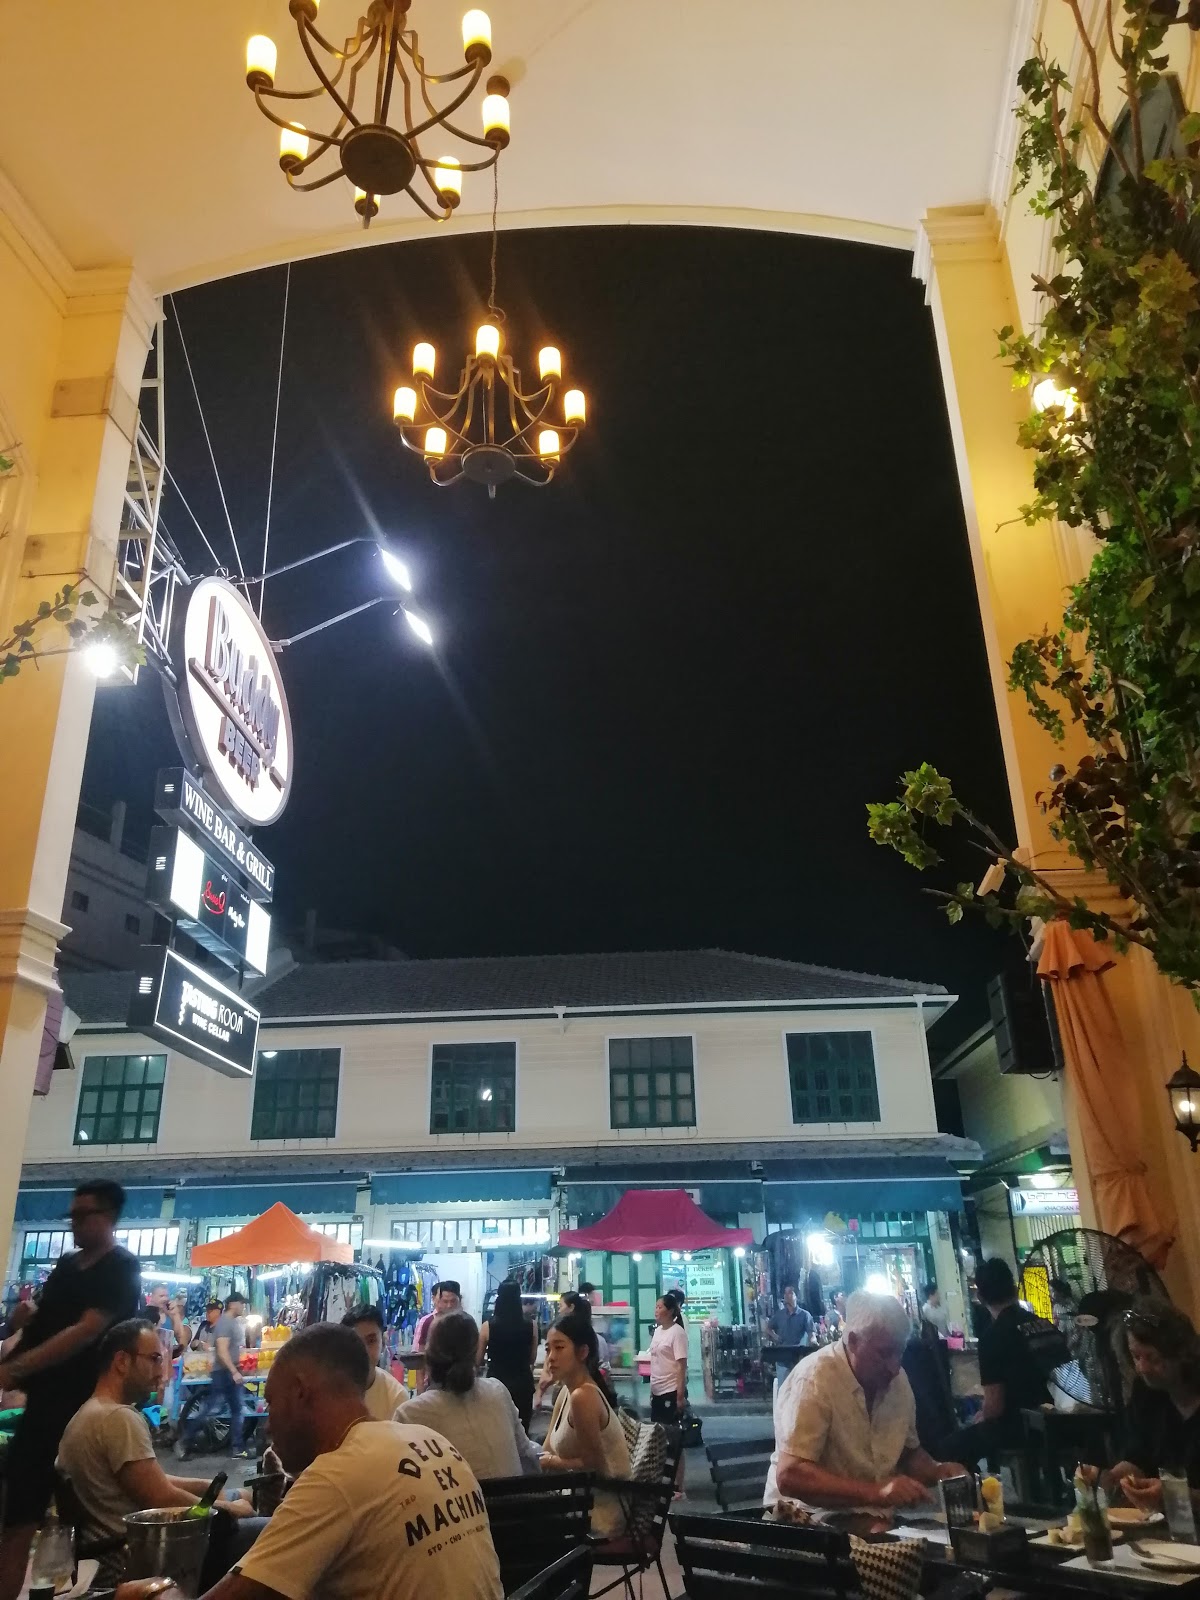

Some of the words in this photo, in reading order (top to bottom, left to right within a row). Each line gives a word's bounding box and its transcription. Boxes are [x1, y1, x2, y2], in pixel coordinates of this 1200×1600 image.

[218, 716, 260, 793] BEER
[184, 781, 214, 831] WINE
[213, 814, 236, 855] BAR
[236, 841, 246, 865] &
[245, 851, 272, 892] GRILL
[192, 1012, 208, 1031] WINE
[207, 1022, 231, 1043] CELLAR
[217, 1004, 244, 1035] ROOM
[398, 1439, 463, 1479] DEUS
[432, 1466, 460, 1491] EX
